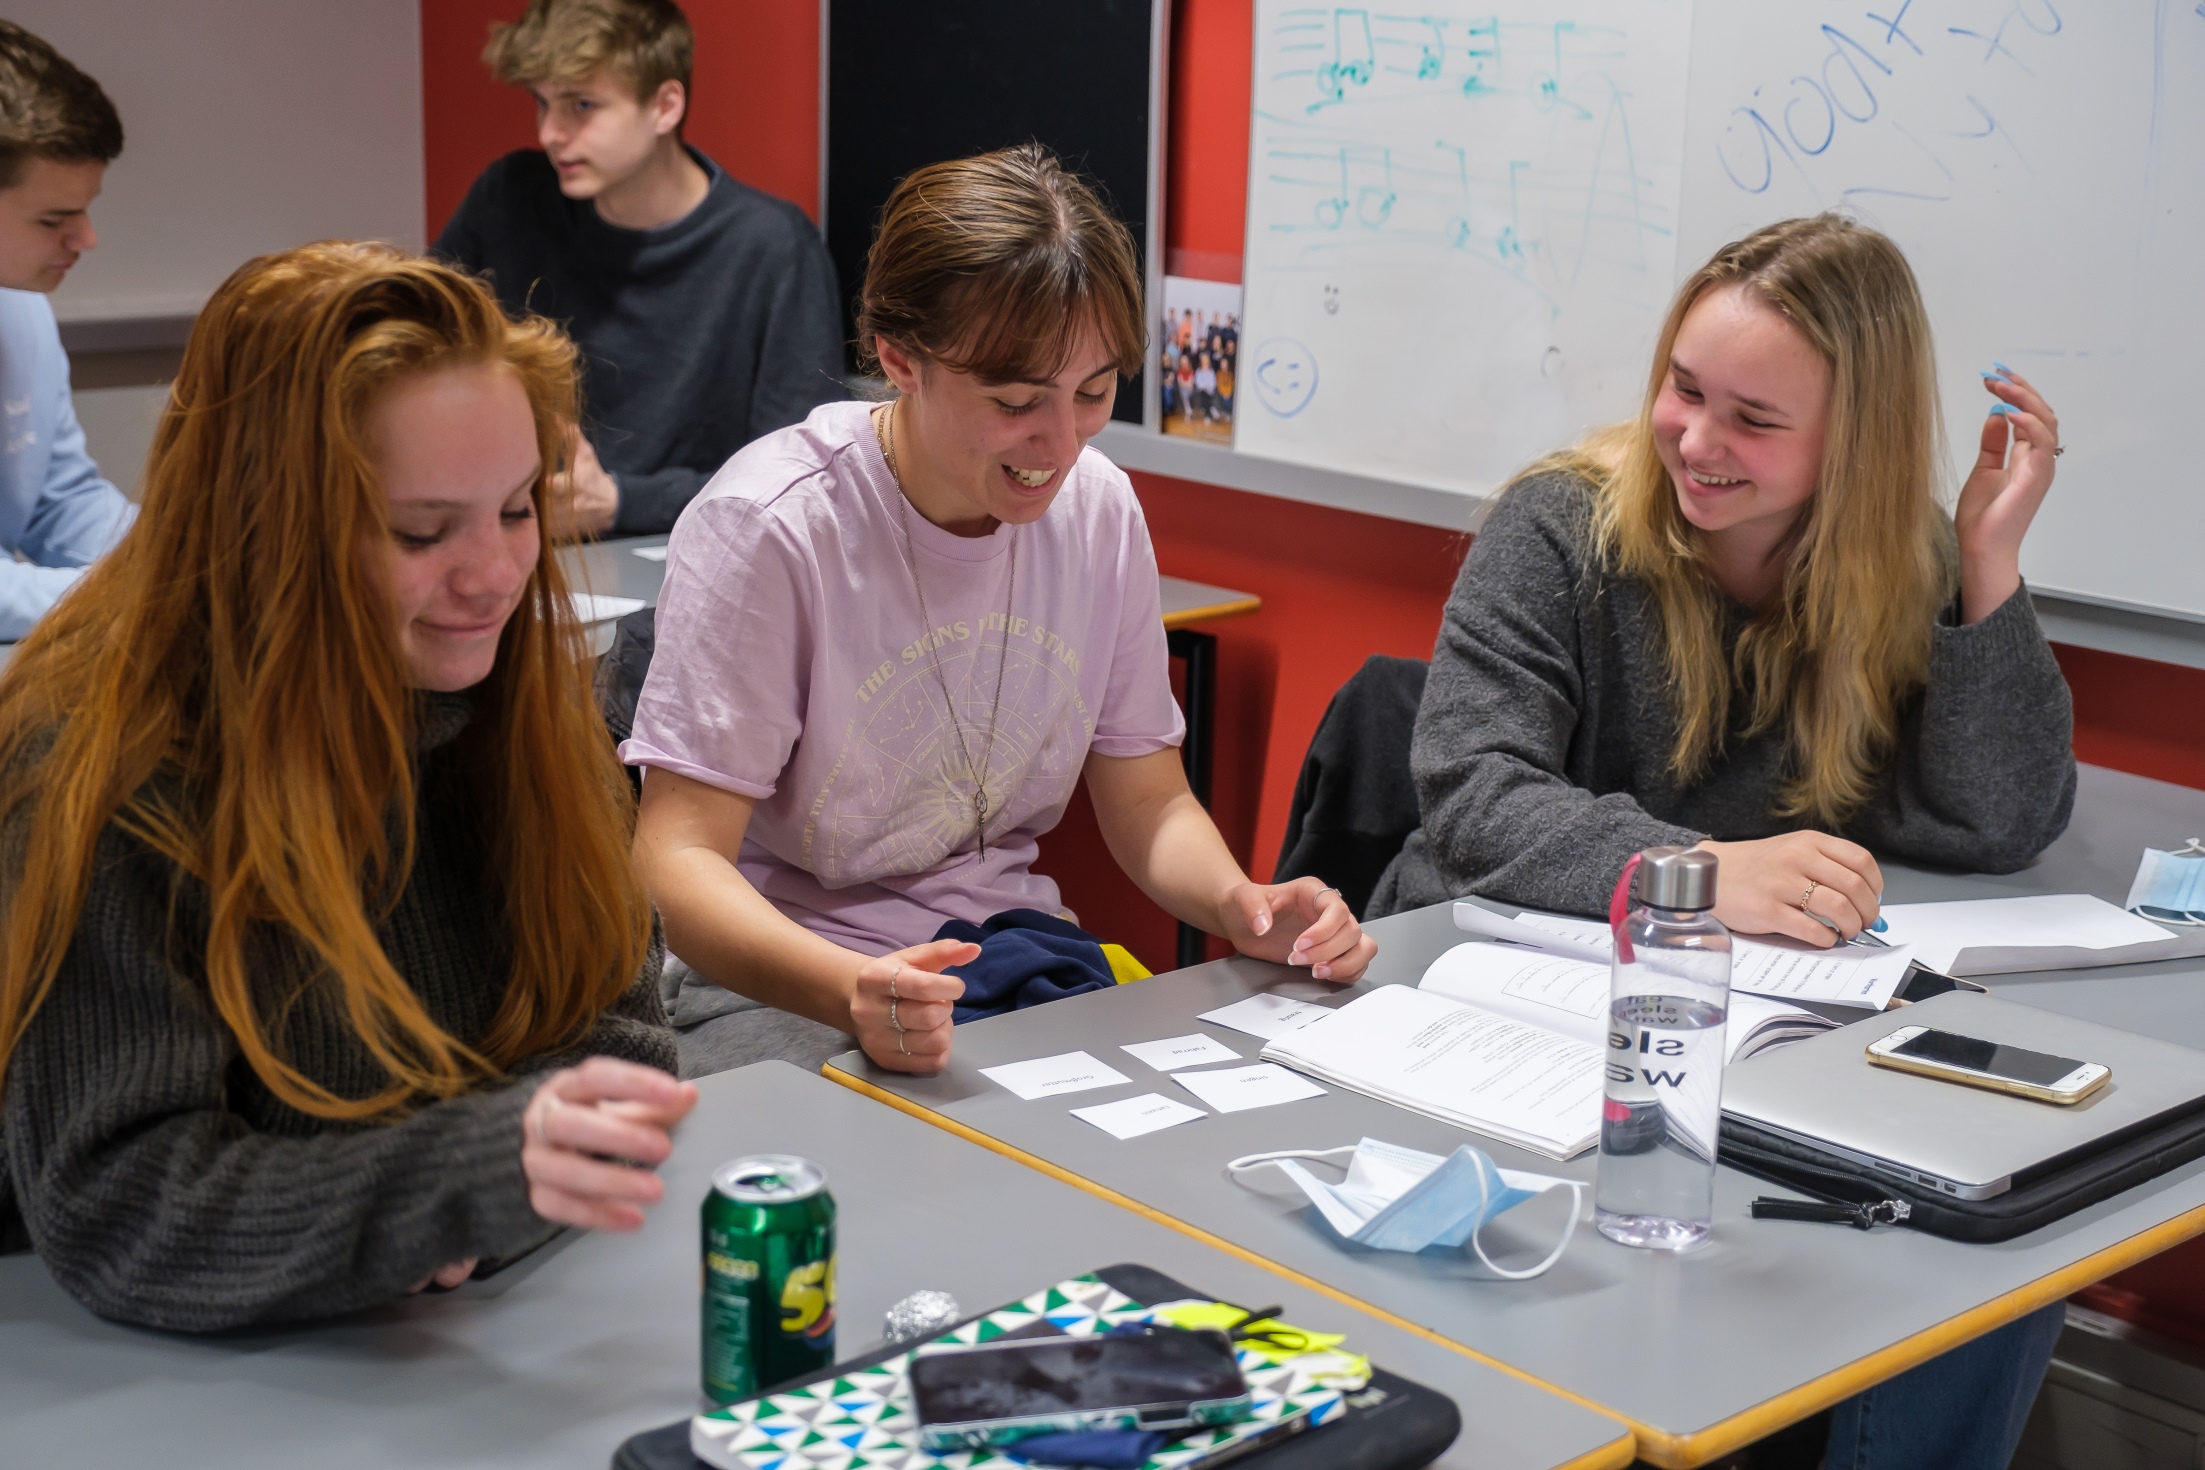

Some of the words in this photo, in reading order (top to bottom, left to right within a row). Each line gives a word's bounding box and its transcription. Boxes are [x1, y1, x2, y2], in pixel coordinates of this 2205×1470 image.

[855, 660, 896, 704] THE
[901, 620, 971, 666] SIGNS
[987, 611, 1029, 637] THE
[1032, 625, 1081, 677] STARS
[825, 743, 849, 786] STARS
[809, 788, 831, 817] WILL
